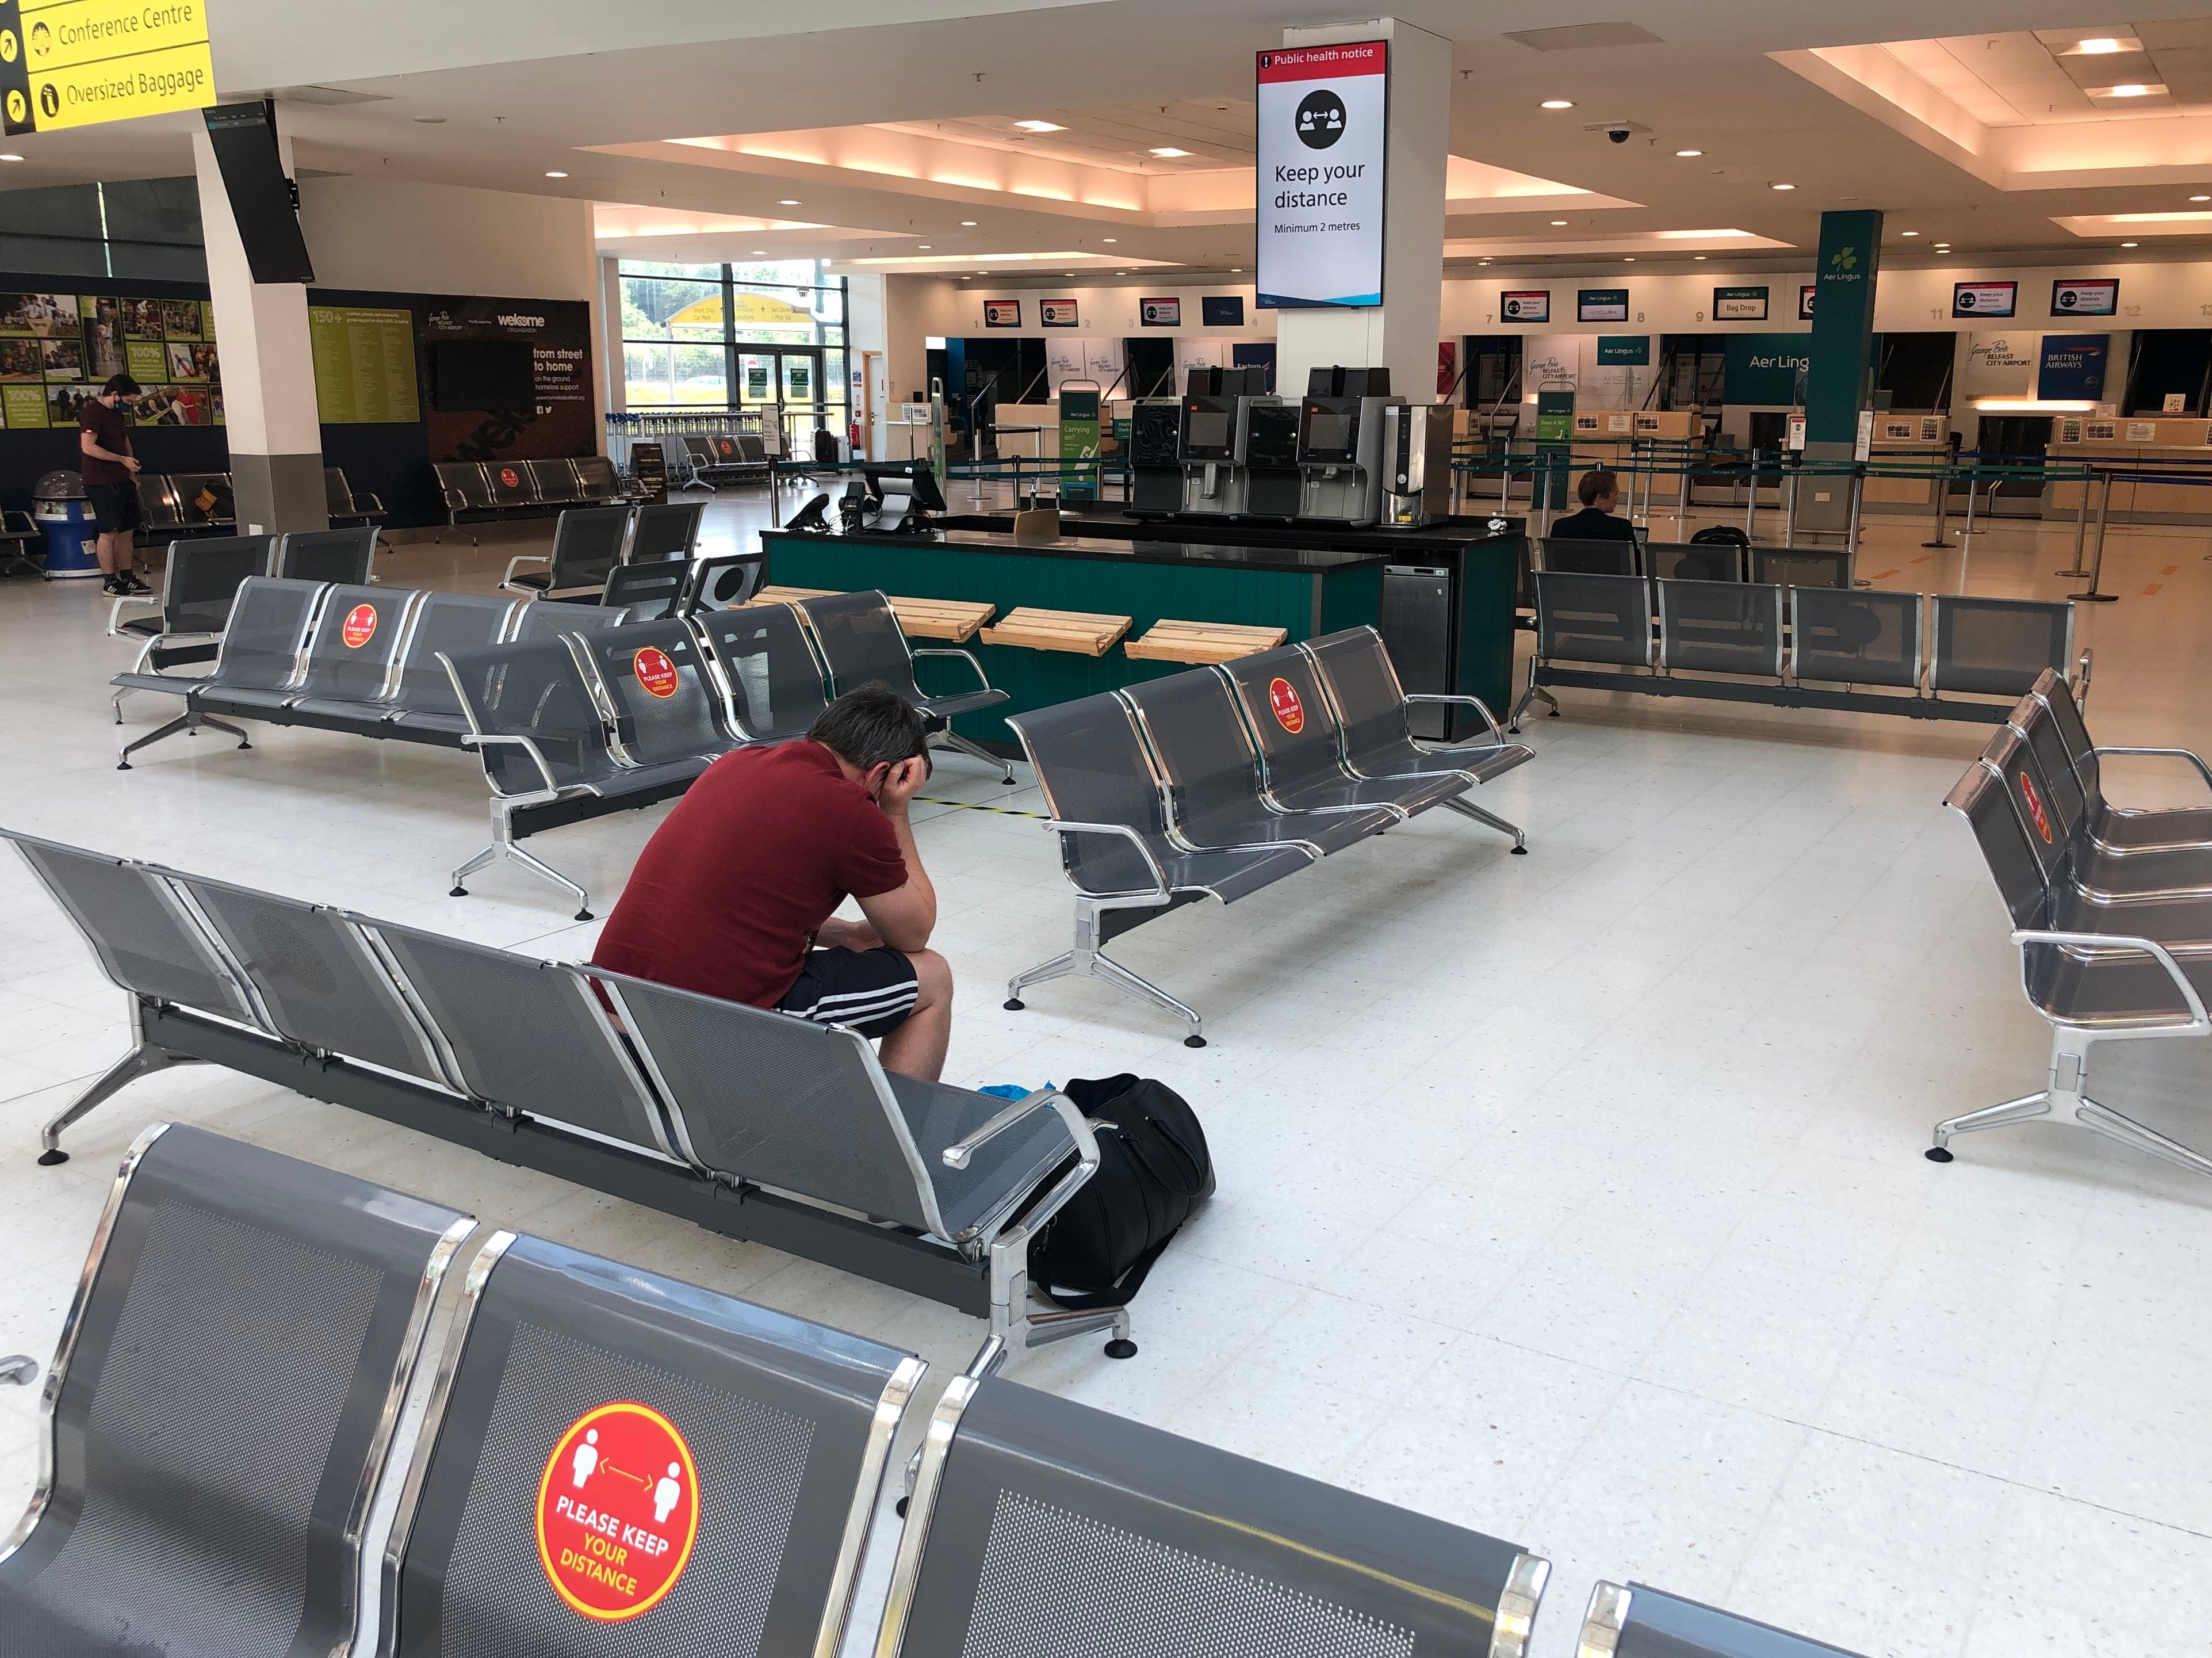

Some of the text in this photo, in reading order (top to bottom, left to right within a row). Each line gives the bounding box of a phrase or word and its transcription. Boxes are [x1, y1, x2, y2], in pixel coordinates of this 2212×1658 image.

[59, 4, 193, 45] Conference Centre
[1274, 47, 1373, 66] Public health notice
[66, 68, 204, 105] Oversized Baggage
[1275, 163, 1365, 184] Keep your
[1275, 190, 1348, 208] distance
[1275, 221, 1360, 234] Minimum 2 metres
[1837, 273, 1861, 281] Lingus
[1726, 304, 1756, 312] Bag Drop
[2124, 305, 2141, 317] 12
[1486, 314, 1492, 324] 7
[1637, 312, 1645, 322] 8
[1696, 311, 1704, 322] 9
[1931, 308, 1943, 320] 11
[497, 313, 545, 327] welcome
[974, 320, 978, 328] 1
[1085, 319, 1091, 328] 2
[1128, 319, 1135, 328] 3
[1252, 317, 1258, 327] 4
[533, 347, 583, 360] from street
[1614, 347, 1634, 356] Lingus
[1969, 340, 2009, 361] George Best
[534, 361, 573, 372] to home
[1530, 357, 1559, 376] George Best
[1749, 356, 1810, 372] Aer Ling
[552, 376, 571, 384] ground
[1064, 426, 1090, 434] Carrying
[643, 674, 660, 682] PLEASE
[652, 683, 673, 692] DISTANCE
[1278, 708, 1291, 716] PLEASE
[556, 1494, 669, 1557] PLEASE KEEP
[584, 1531, 628, 1567] YOUR
[560, 1548, 638, 1596] DISTANCE
